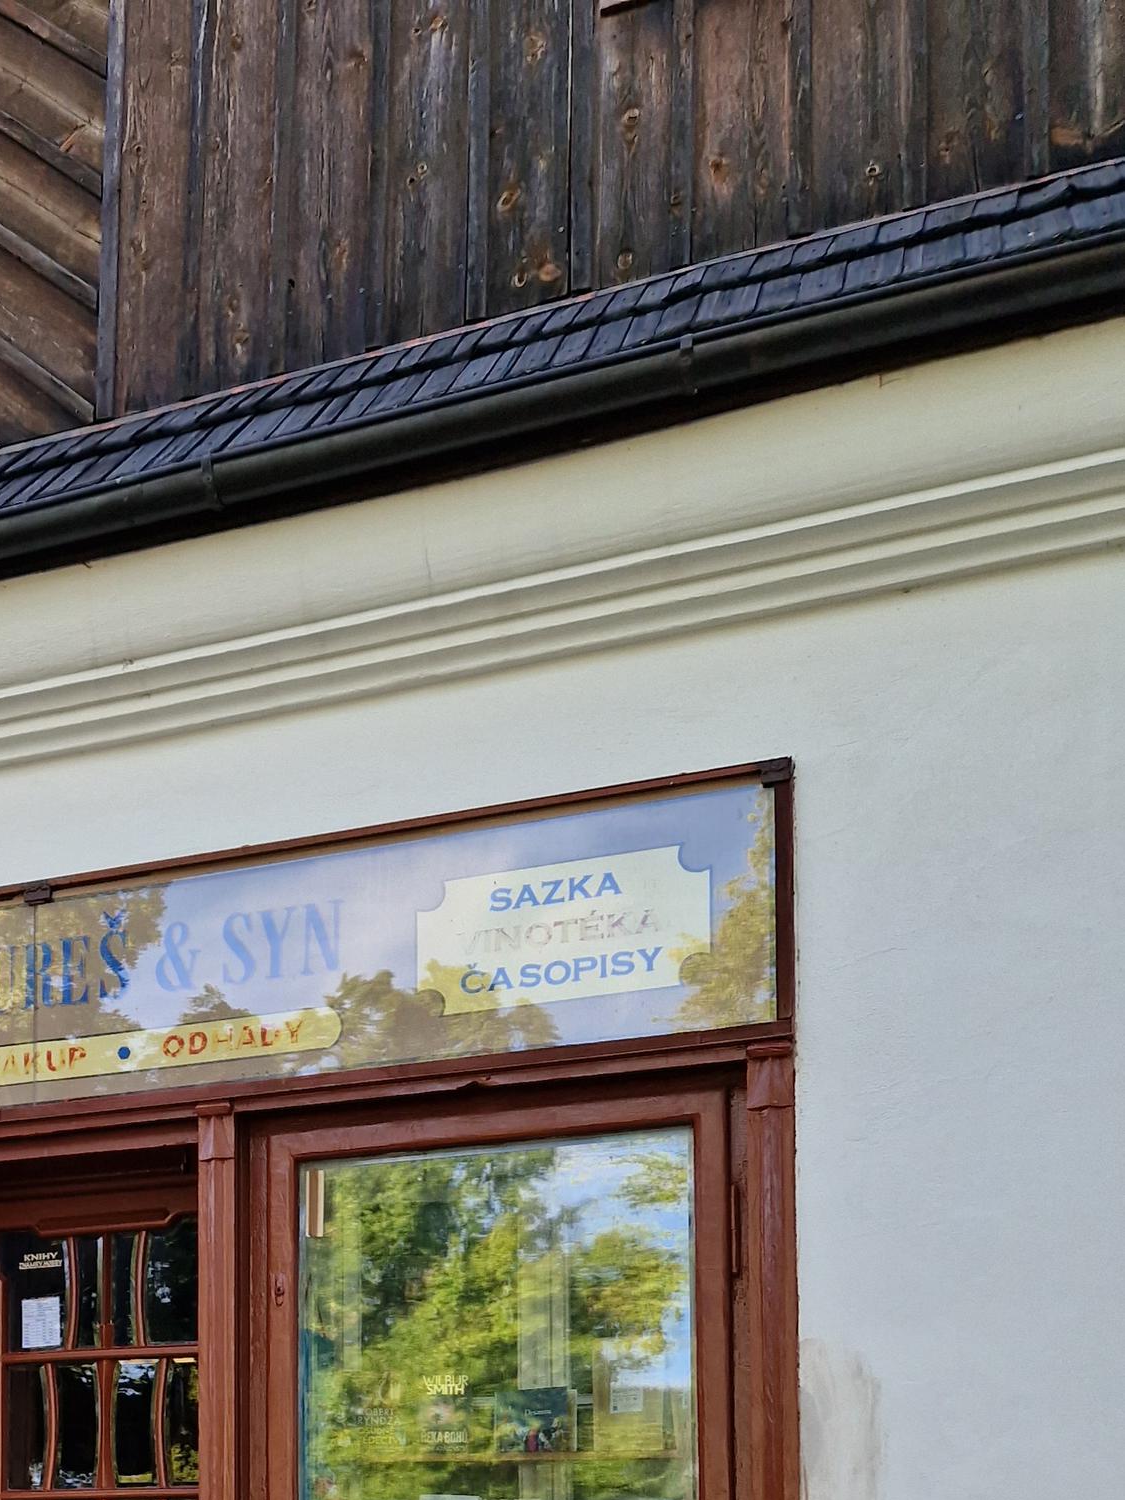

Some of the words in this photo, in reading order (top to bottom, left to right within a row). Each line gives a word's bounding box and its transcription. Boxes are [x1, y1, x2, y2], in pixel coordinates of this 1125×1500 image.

[488, 871, 623, 912] SAZKA
[155, 920, 202, 993] &
[221, 898, 345, 985] SYN
[456, 909, 660, 954] VINOTÉKA
[459, 945, 664, 995] ČASOPISY
[23, 1251, 59, 1262] KNIHY
[423, 1374, 469, 1386] WILBUR
[427, 1383, 465, 1395] SMITH
